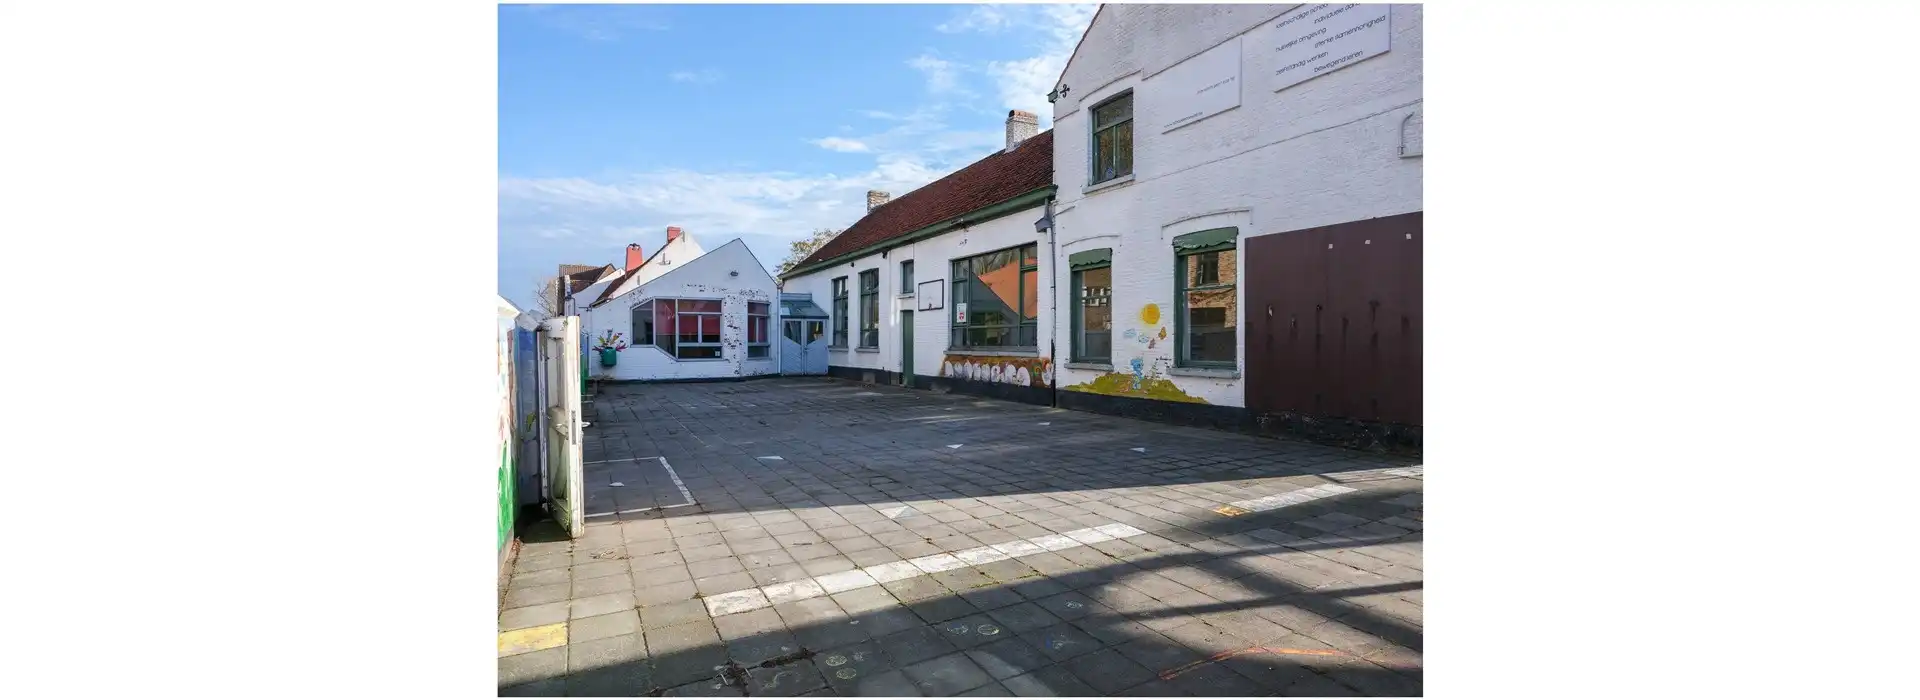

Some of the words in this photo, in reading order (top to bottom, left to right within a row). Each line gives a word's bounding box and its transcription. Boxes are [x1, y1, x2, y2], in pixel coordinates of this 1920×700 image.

[1299, 27, 1327, 42] omgeving
[1314, 36, 1334, 48] sterke
[1276, 59, 1306, 75] zelfstandig
[1307, 51, 1329, 63] werken
[1314, 56, 1346, 72] bewegend
[1346, 49, 1364, 61] leren
